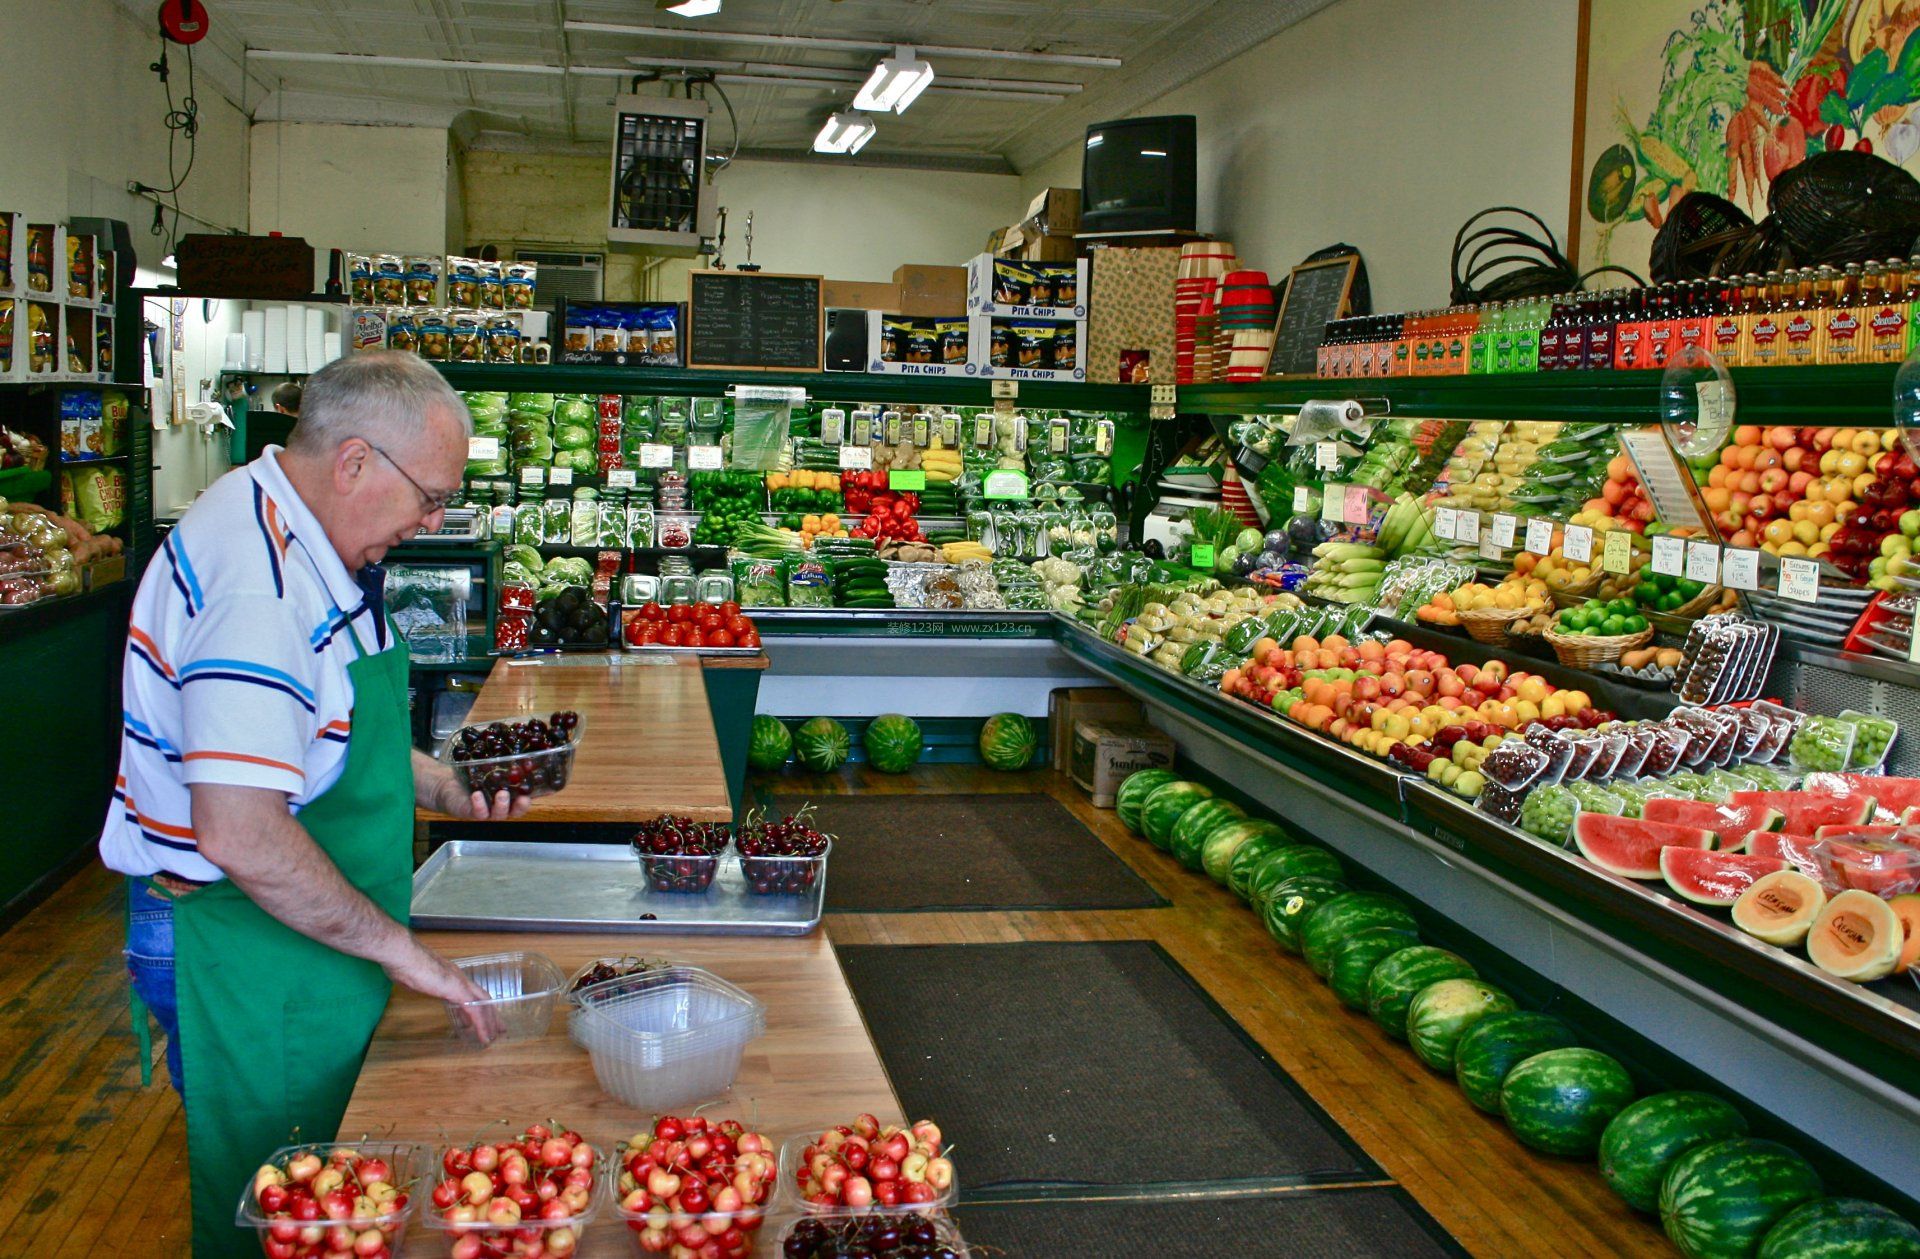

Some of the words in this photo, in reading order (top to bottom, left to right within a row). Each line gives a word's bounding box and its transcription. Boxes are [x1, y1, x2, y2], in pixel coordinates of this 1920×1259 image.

[1011, 306, 1030, 316] PITA
[1033, 307, 1056, 317] CHIPS
[902, 364, 920, 374] PITA
[923, 365, 947, 375] CHIPS
[1010, 368, 1029, 378] PITA
[1032, 369, 1055, 379] CHIPS
